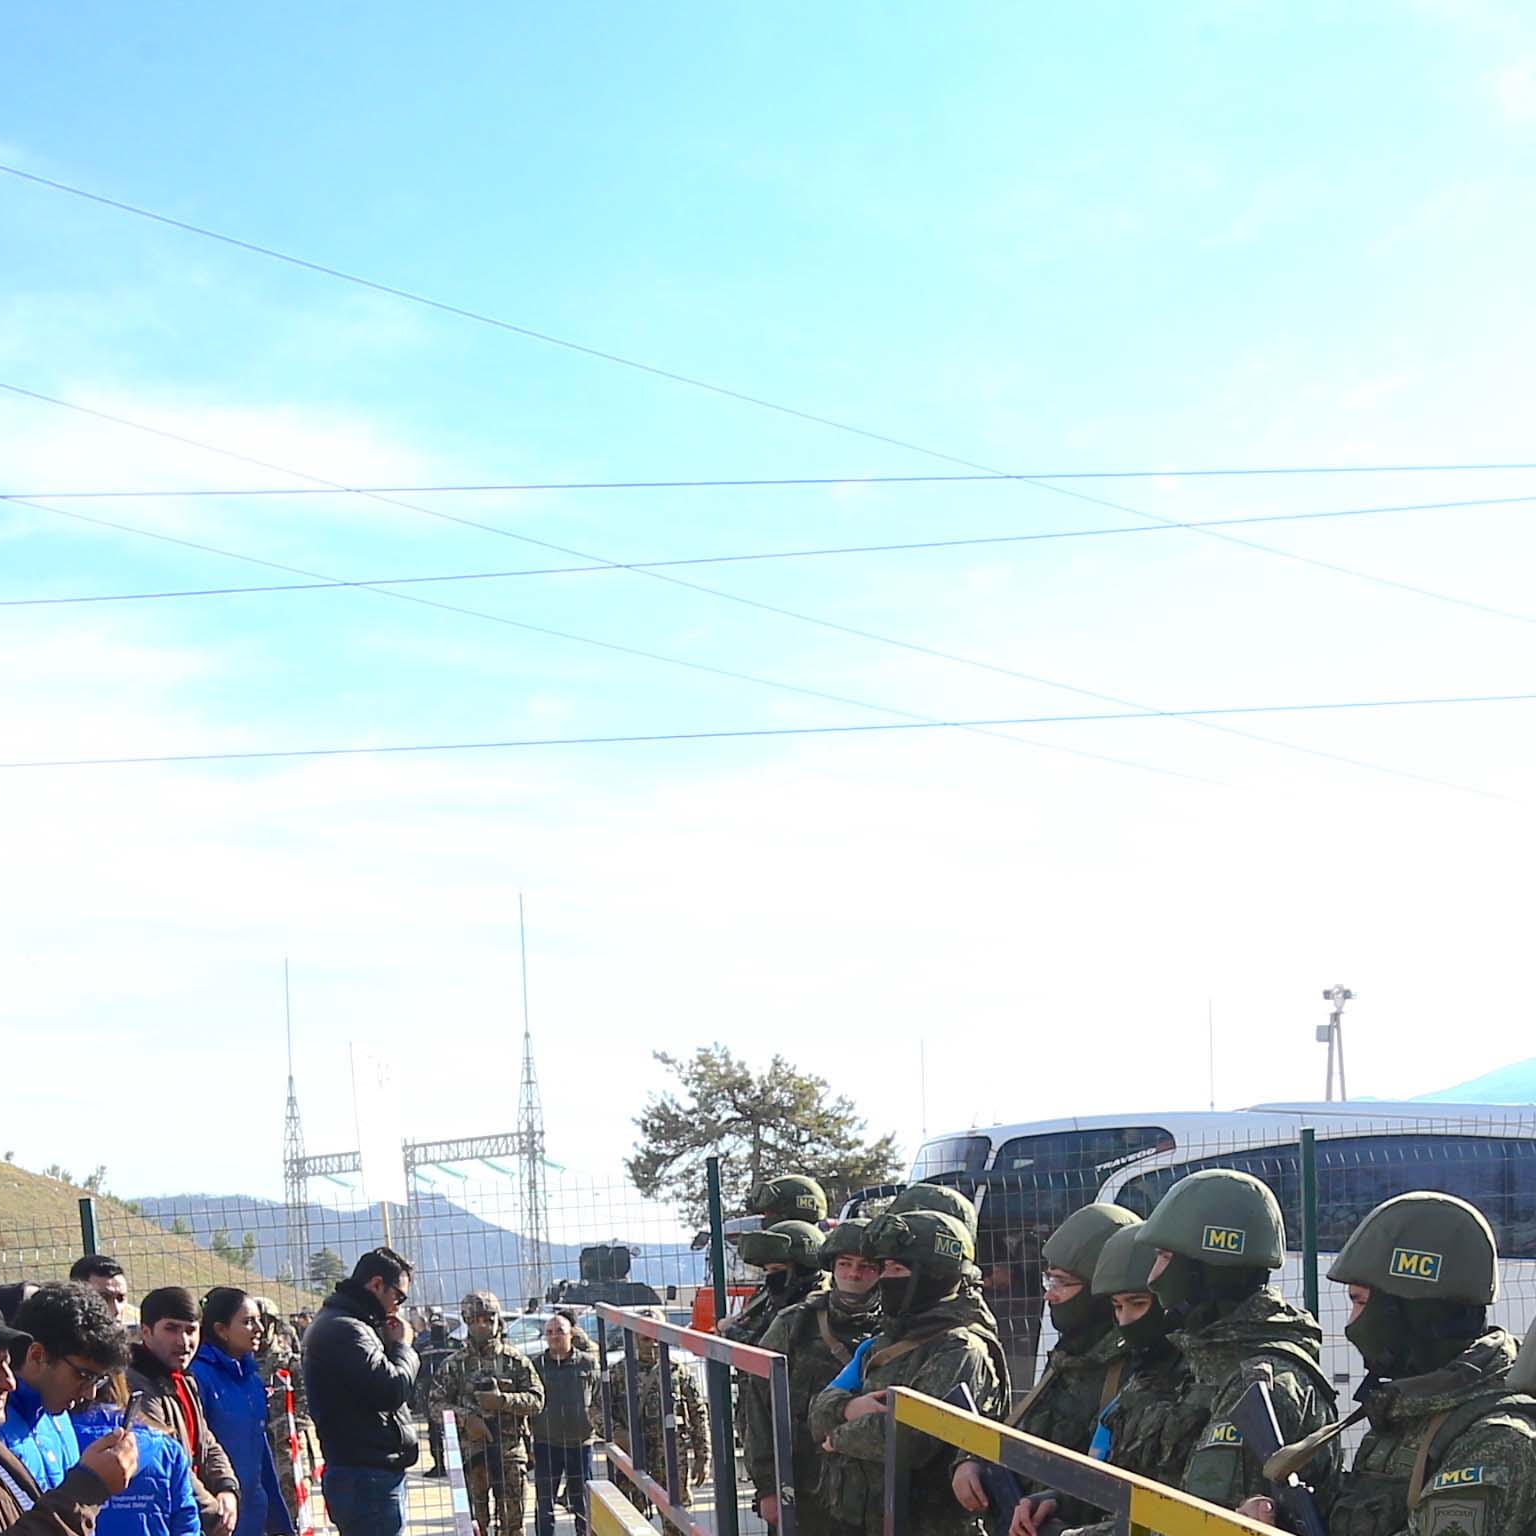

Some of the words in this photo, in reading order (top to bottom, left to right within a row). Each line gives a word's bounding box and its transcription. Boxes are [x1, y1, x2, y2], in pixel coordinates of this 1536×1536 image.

[1209, 1229, 1239, 1249] МС
[1397, 1252, 1434, 1276] МС
[1211, 1425, 1238, 1442] МС
[1440, 1466, 1475, 1484] МС
